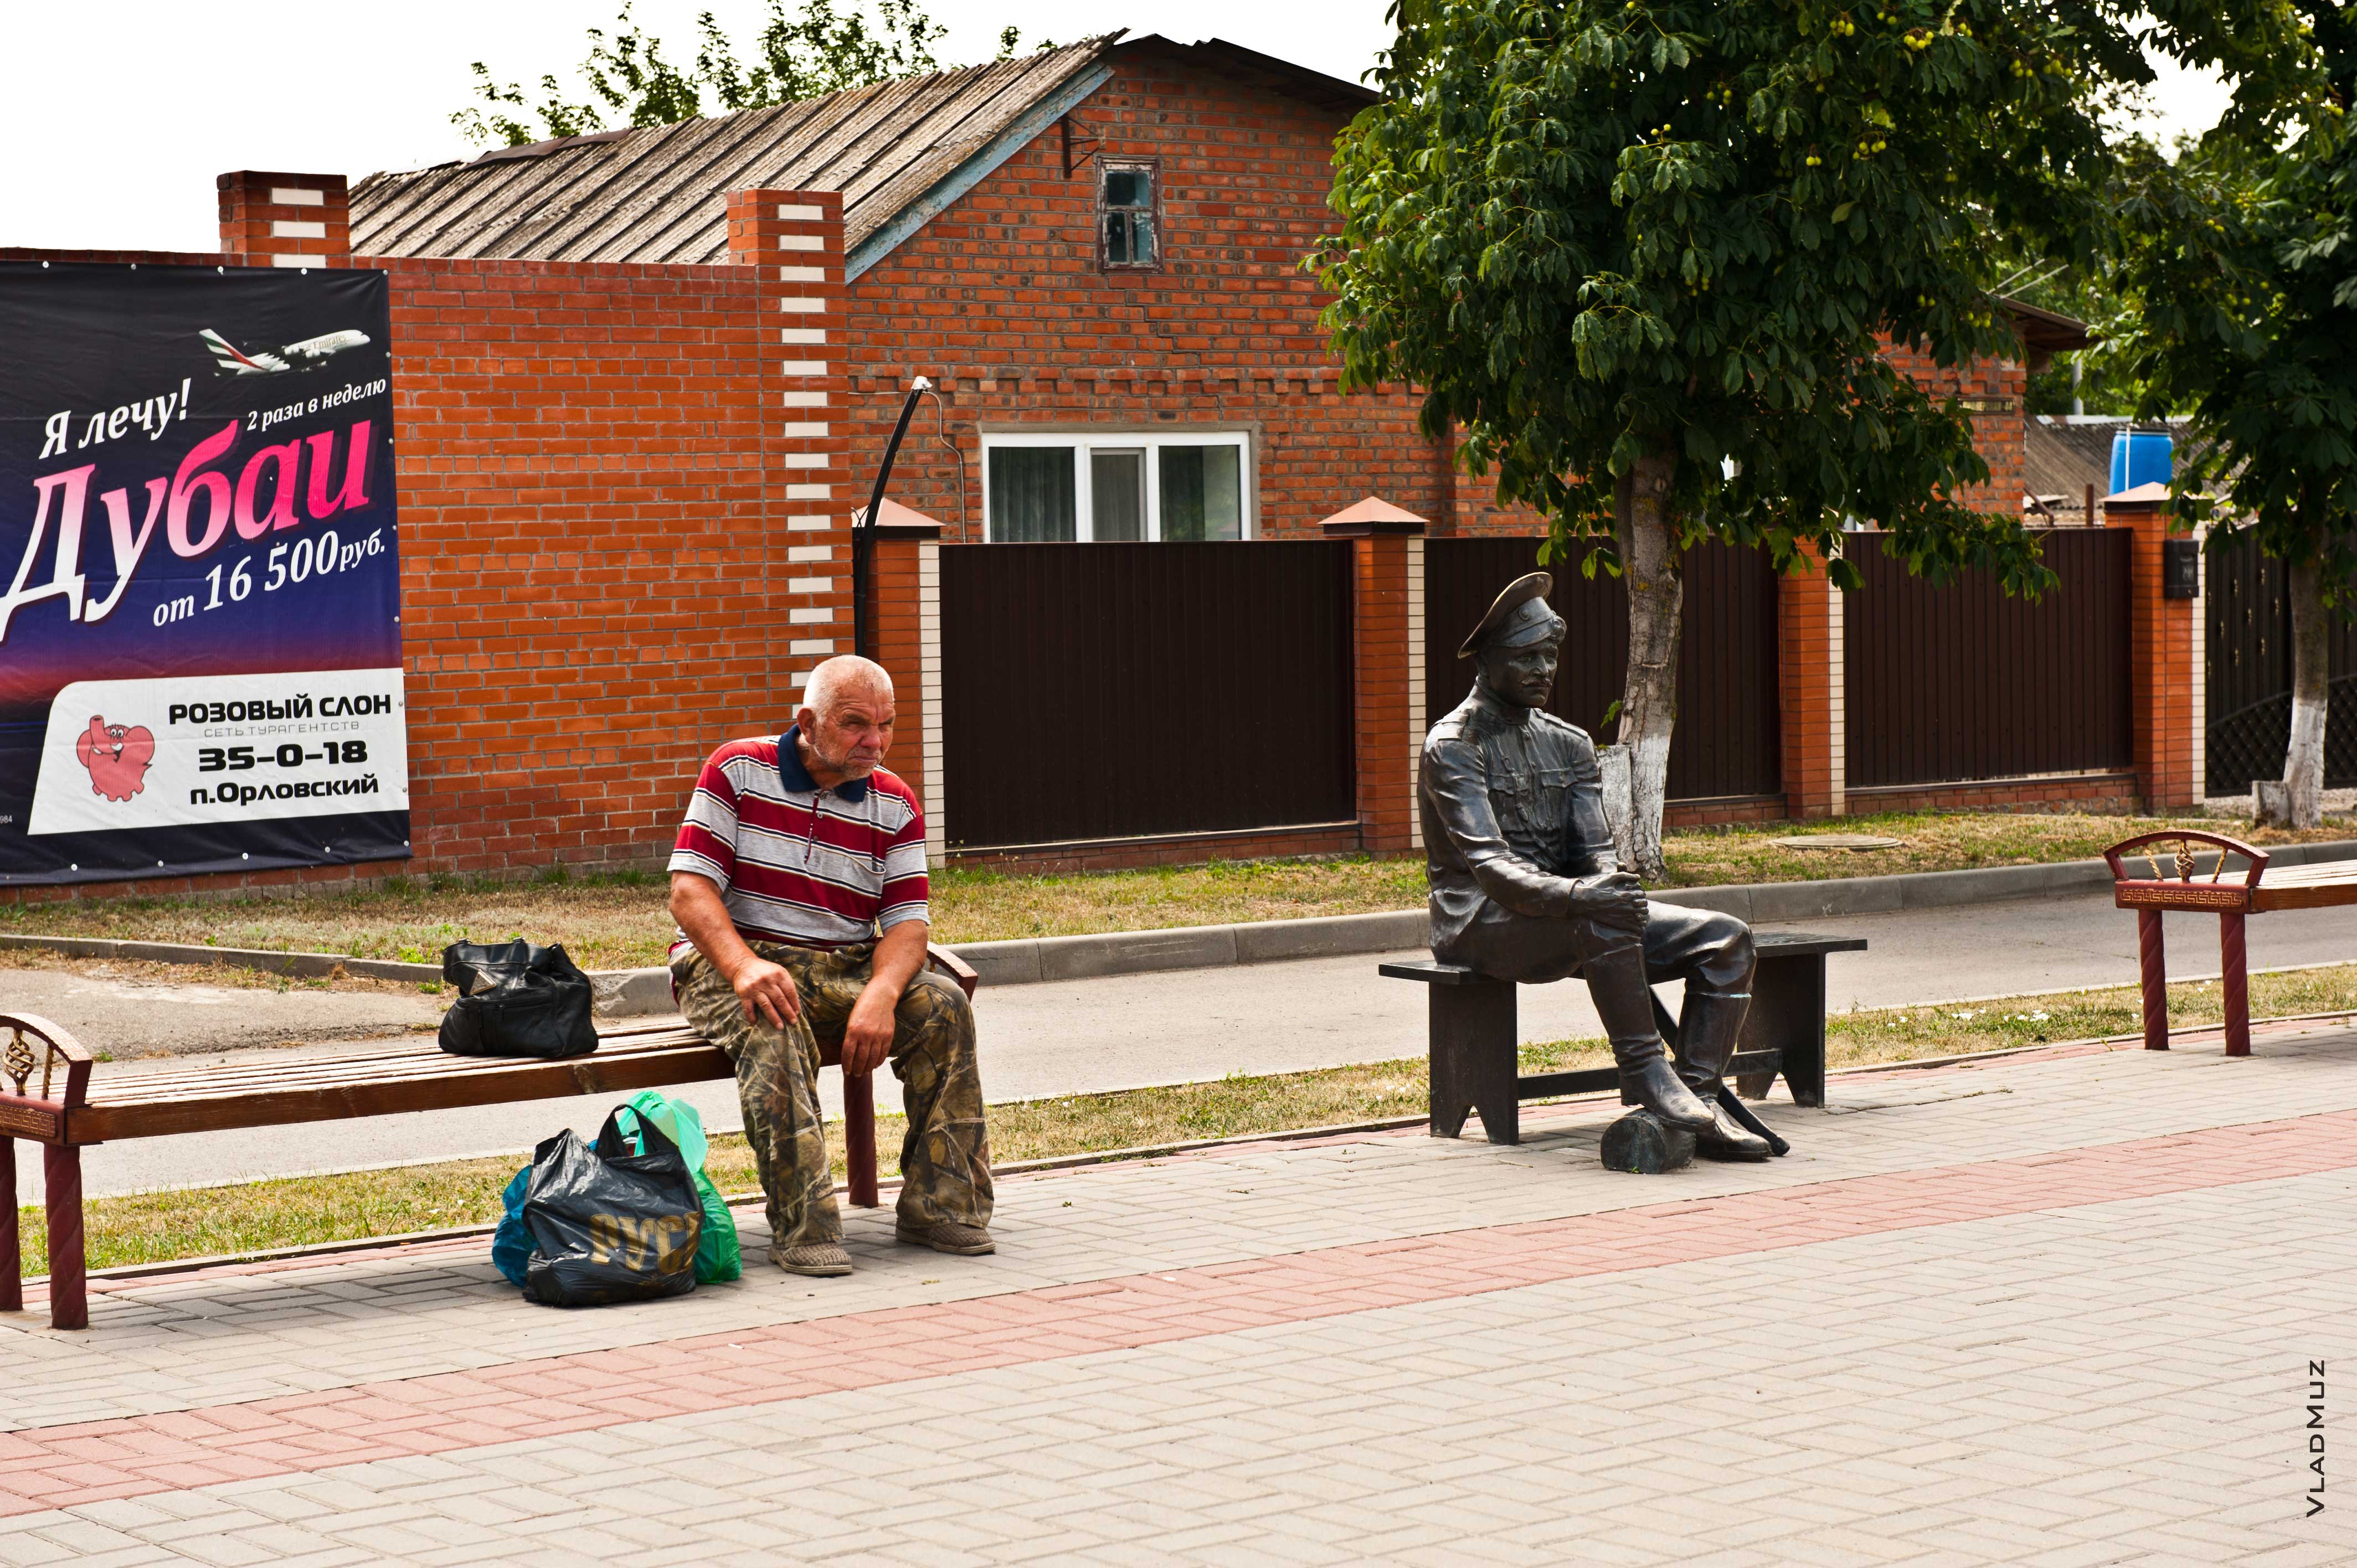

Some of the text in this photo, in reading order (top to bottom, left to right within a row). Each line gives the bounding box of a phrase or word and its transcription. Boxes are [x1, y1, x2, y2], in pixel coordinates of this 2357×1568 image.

[38, 377, 192, 460] Я лечу!
[247, 378, 386, 432] 2 раза в неделю
[0, 419, 371, 641] Дубаи
[153, 595, 194, 627] от
[203, 555, 252, 611] 16
[168, 693, 392, 725] РОЗОВЫЙ СЛОН
[204, 721, 359, 737] СЕТЬ ТУРАГЕНТСТВ
[198, 740, 368, 772] 35-0-18
[190, 773, 379, 806] п.Орловский
